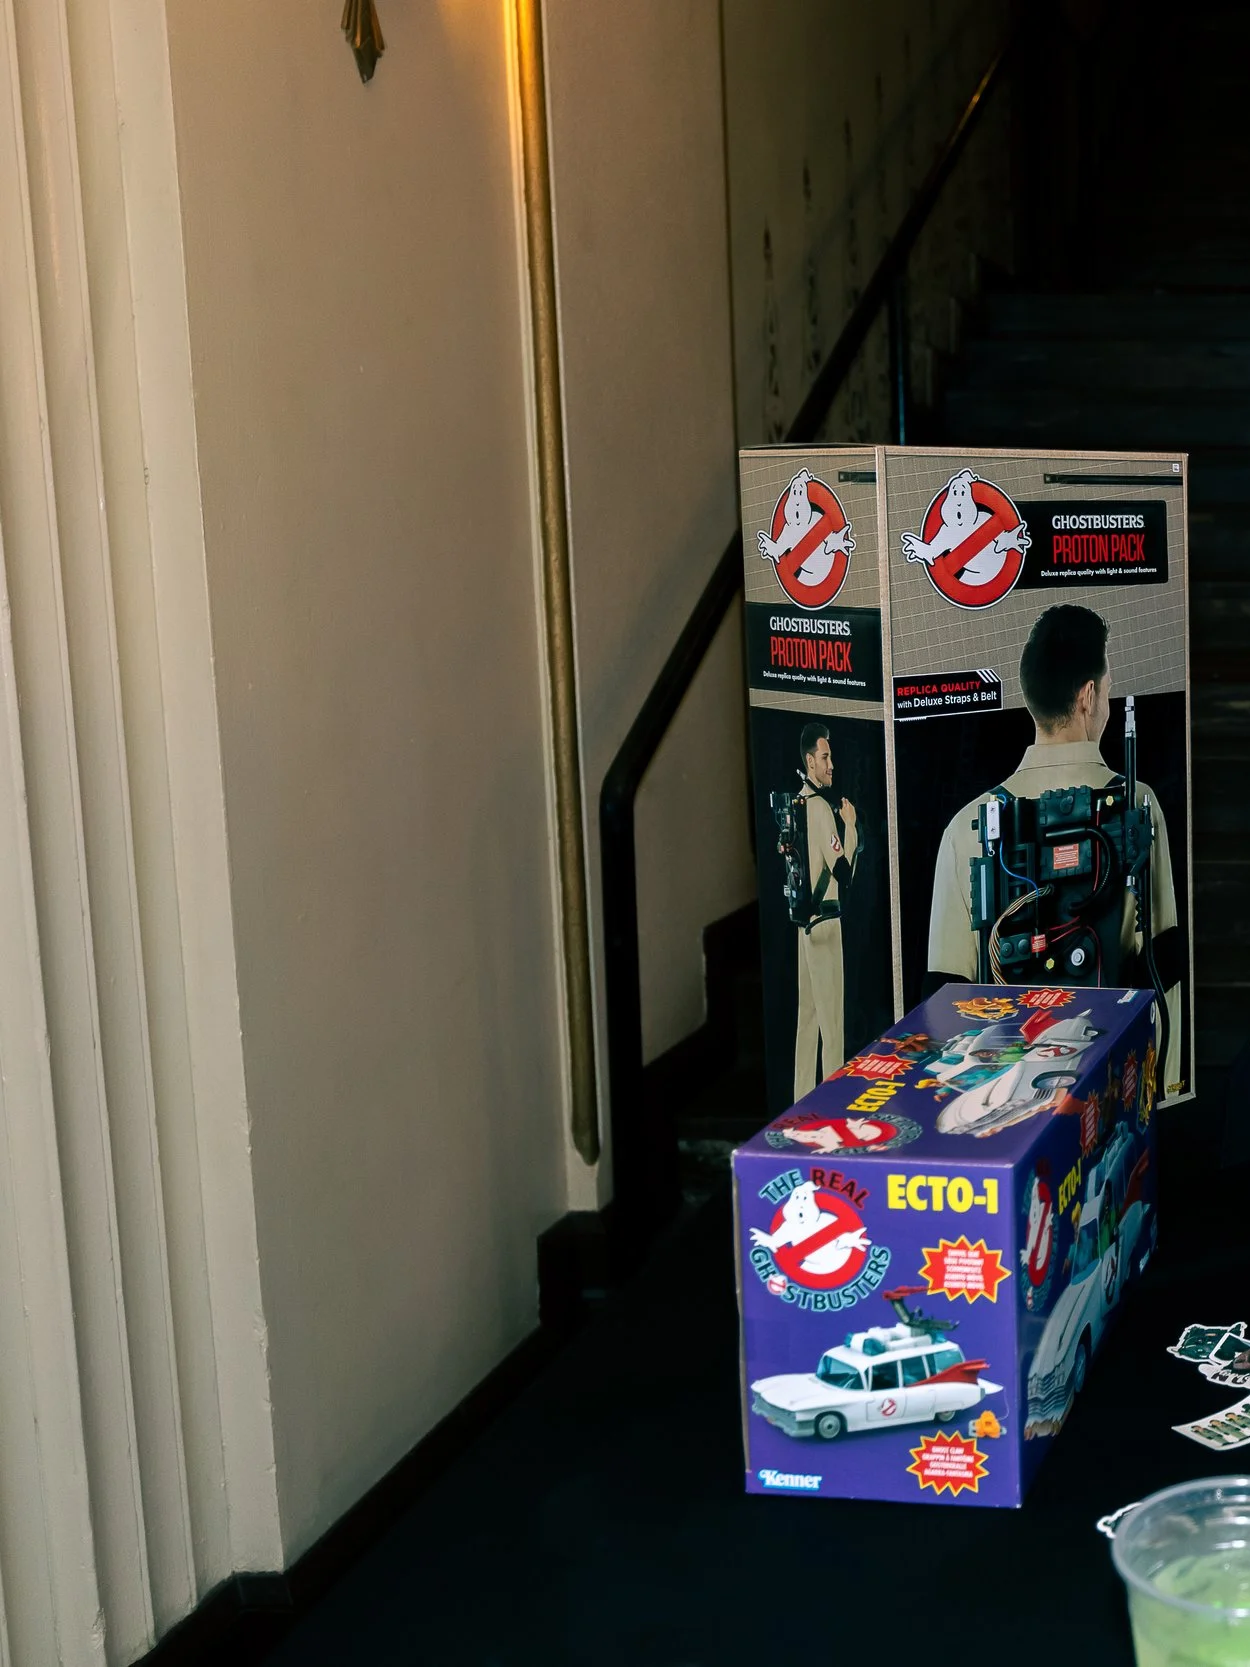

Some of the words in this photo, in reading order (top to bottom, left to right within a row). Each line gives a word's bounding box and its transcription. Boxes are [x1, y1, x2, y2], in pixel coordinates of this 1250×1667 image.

[1051, 514, 1145, 529] GHOSTBUSTERS
[1052, 534, 1109, 564] PROTON
[1110, 533, 1145, 562] PACK
[1059, 568, 1077, 578] replica
[1077, 568, 1094, 577] quality
[1094, 567, 1107, 575] with
[1107, 567, 1118, 576] light
[1138, 566, 1157, 574] features
[769, 616, 851, 636] GHOSTBUSTERS
[770, 635, 818, 670] PROTON
[819, 639, 853, 673] PACK
[777, 672, 792, 681] replica
[791, 673, 806, 683] quality
[816, 675, 827, 684] light
[846, 678, 866, 687] features
[896, 684, 938, 697] REPLICA
[940, 681, 981, 693] QUALITY
[897, 700, 913, 709] with
[913, 696, 943, 708] Deluxe
[944, 694, 971, 705] Straps
[972, 692, 979, 702] &
[980, 690, 997, 702] Belt
[760, 1169, 804, 1203] THE
[811, 1168, 869, 1210] REAL
[887, 1174, 998, 1214] ECTO-1
[759, 1468, 822, 1489] Kenner
